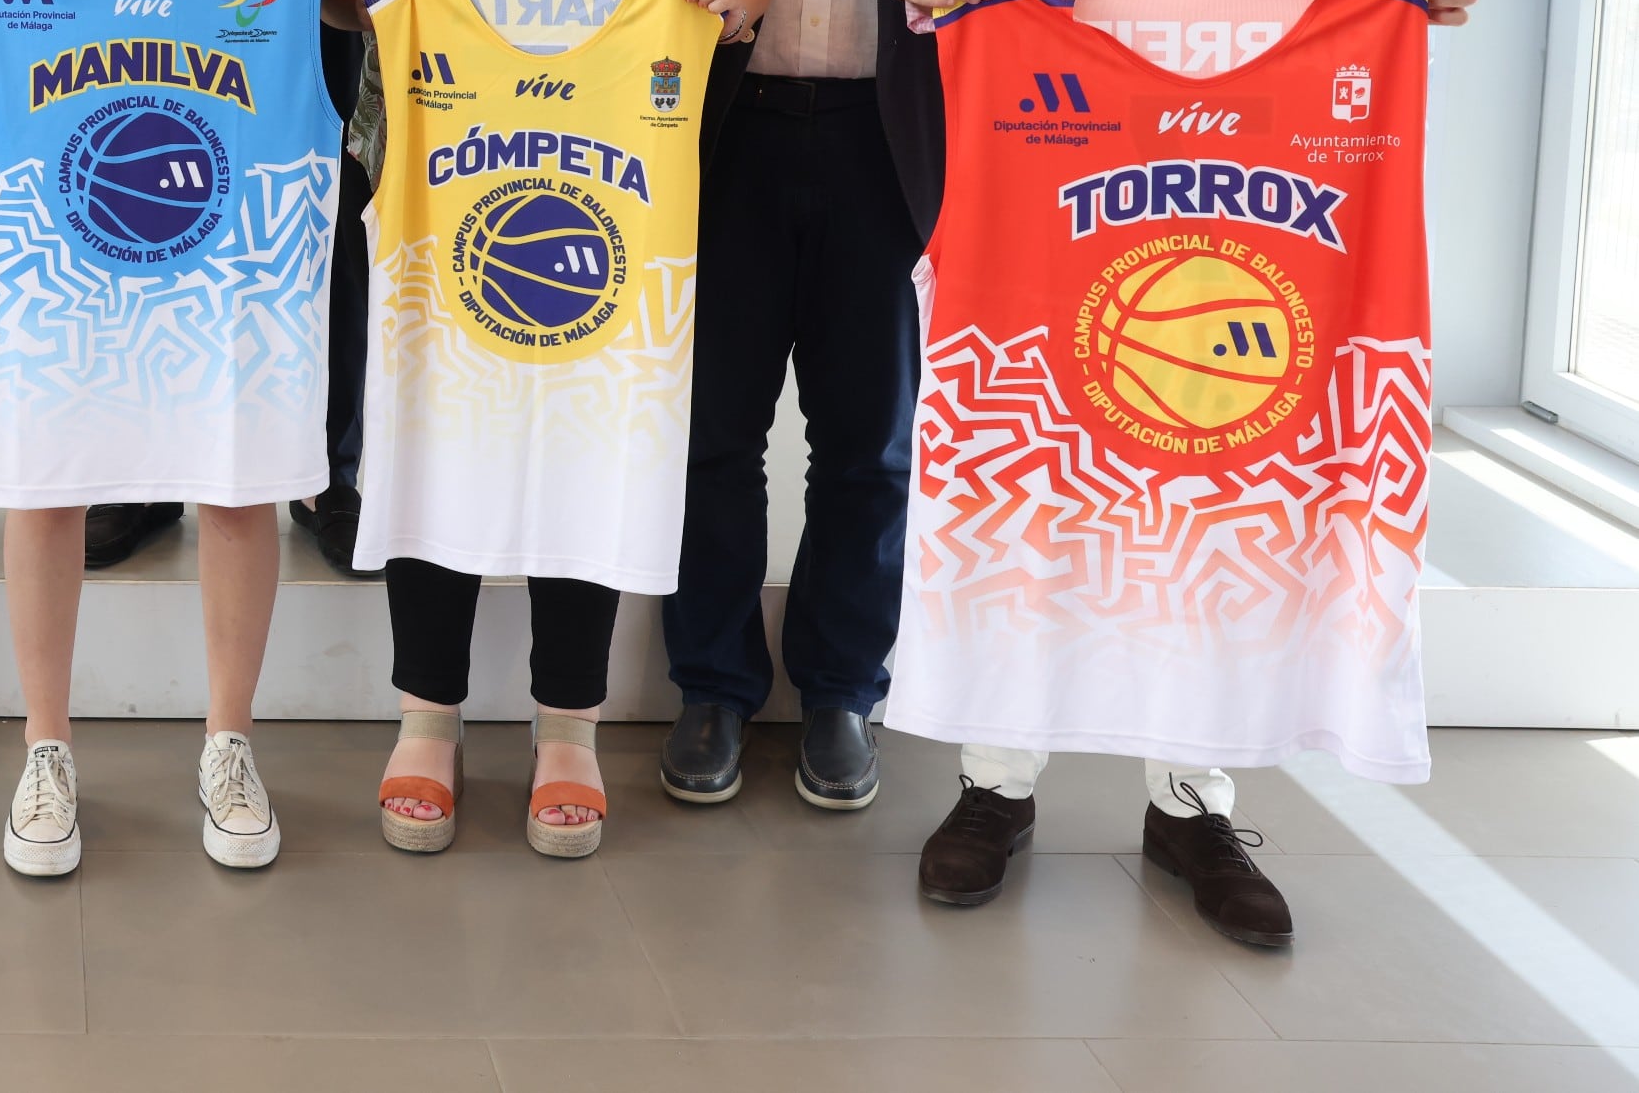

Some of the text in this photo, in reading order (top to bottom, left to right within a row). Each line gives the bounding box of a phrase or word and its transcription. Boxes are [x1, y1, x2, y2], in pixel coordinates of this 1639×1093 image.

[7, 20, 53, 32] de Málaga
[32, 10, 76, 20] Provincial
[28, 37, 258, 116] MANILVA
[433, 90, 477, 100] Provincial
[423, 98, 454, 111] Málaga
[993, 119, 1122, 134] Diputación Provincial
[58, 95, 231, 195] CAMPUS PROVINCIAL DE BALONCESTO
[427, 121, 653, 207] CÓMPETA
[1025, 132, 1089, 147] de Málaga
[1289, 132, 1402, 151] Ayuntamiento
[1307, 150, 1385, 165] de Torrox
[451, 177, 627, 286] CAMPUS PROVINCIAL DE BALONCESTO
[1058, 158, 1349, 255] TORROX
[64, 210, 224, 265] DIPUTACIÓN DE MÁLAGA
[457, 288, 618, 348] DIPUTACIÓN DE MÁLAGA
[1074, 233, 1316, 370] CAMPUS PROVINCIAL DE BALONCESTO
[1081, 378, 1303, 456] DIPUTACIÓN DE MÁLAGA
